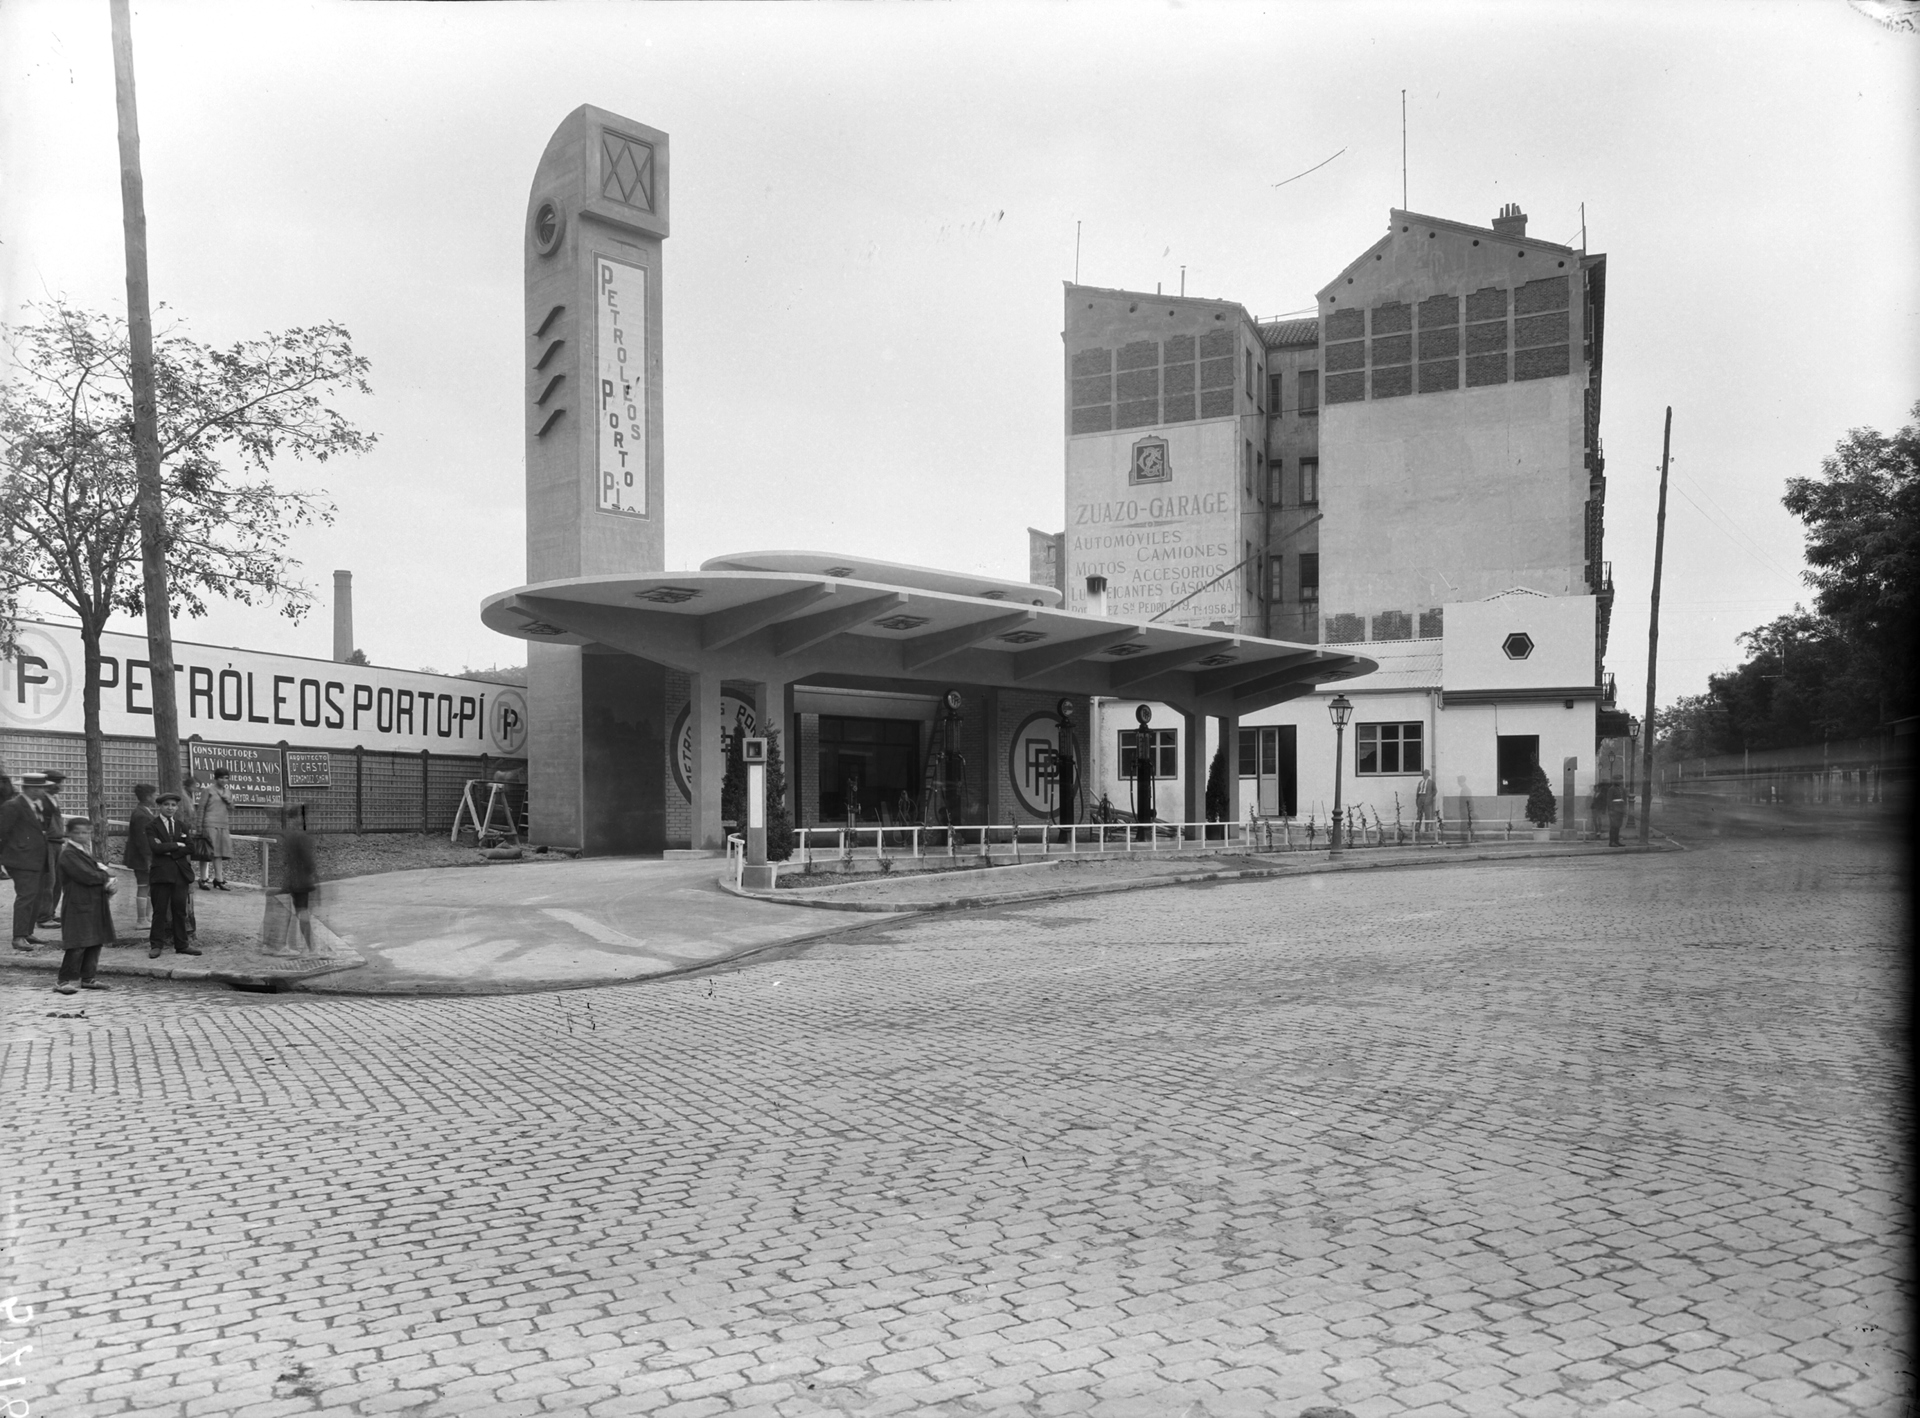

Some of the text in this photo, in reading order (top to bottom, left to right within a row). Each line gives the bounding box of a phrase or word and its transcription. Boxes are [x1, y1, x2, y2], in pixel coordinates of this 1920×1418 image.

[602, 379, 634, 487] PORTO
[1074, 492, 1229, 526] ZUAZO-GARAGE
[1136, 543, 1228, 562] CAMIONES
[1075, 561, 1126, 577] MOTOS
[1132, 564, 1225, 583] ACCESORIOS
[1170, 579, 1234, 595] GASOLINA
[1138, 601, 1168, 614] PEDRO
[352, 684, 486, 740] PORTO-PÍ
[192, 745, 258, 759] CONSTRUCTORES
[194, 757, 281, 775] MAYO HERMANOS
[300, 762, 328, 773] CASTO
